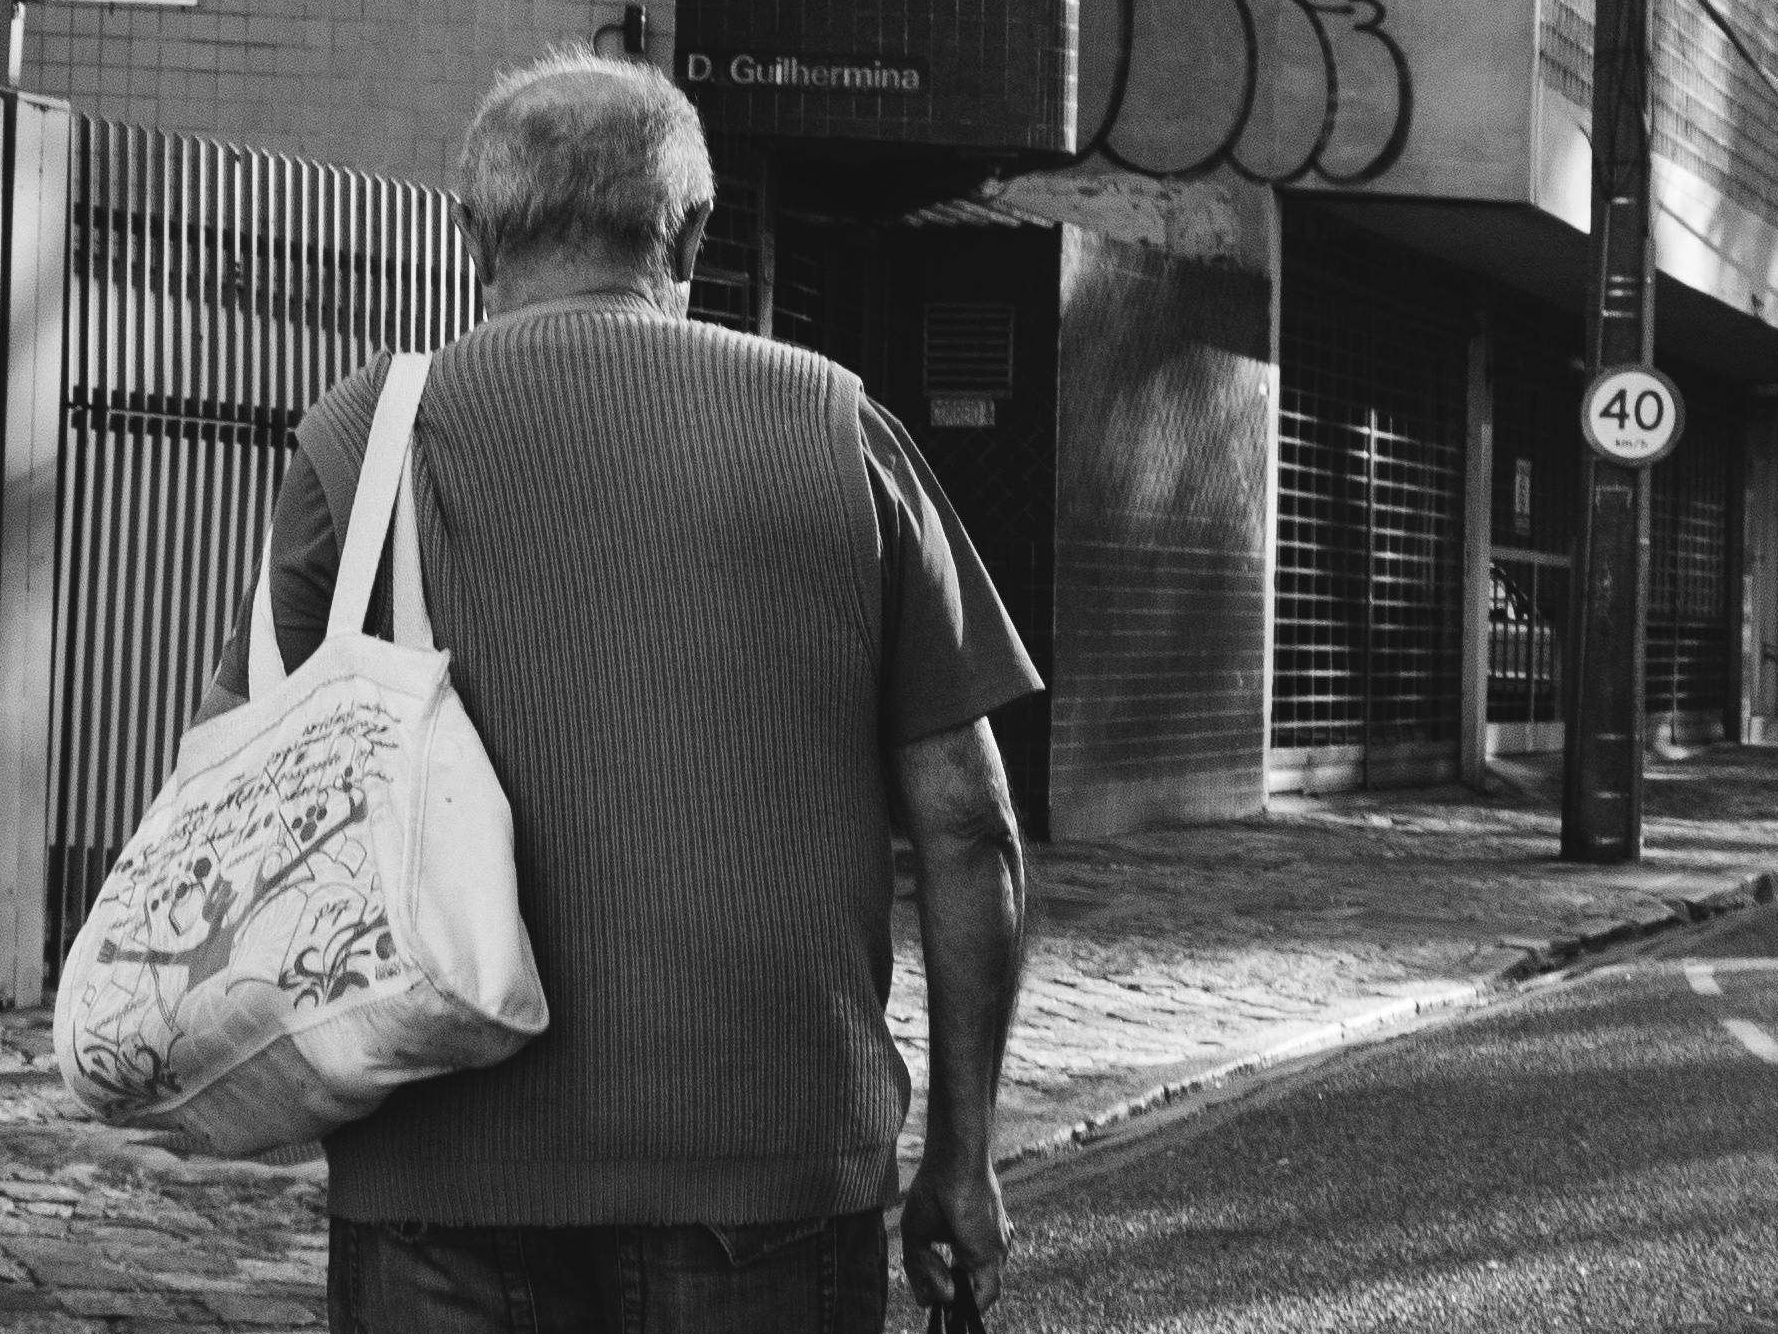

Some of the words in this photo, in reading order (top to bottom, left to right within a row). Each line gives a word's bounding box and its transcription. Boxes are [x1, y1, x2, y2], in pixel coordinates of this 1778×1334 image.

[730, 54, 920, 91] Guilhermina
[1599, 387, 1665, 431] 40
[1614, 437, 1649, 450] km/h
